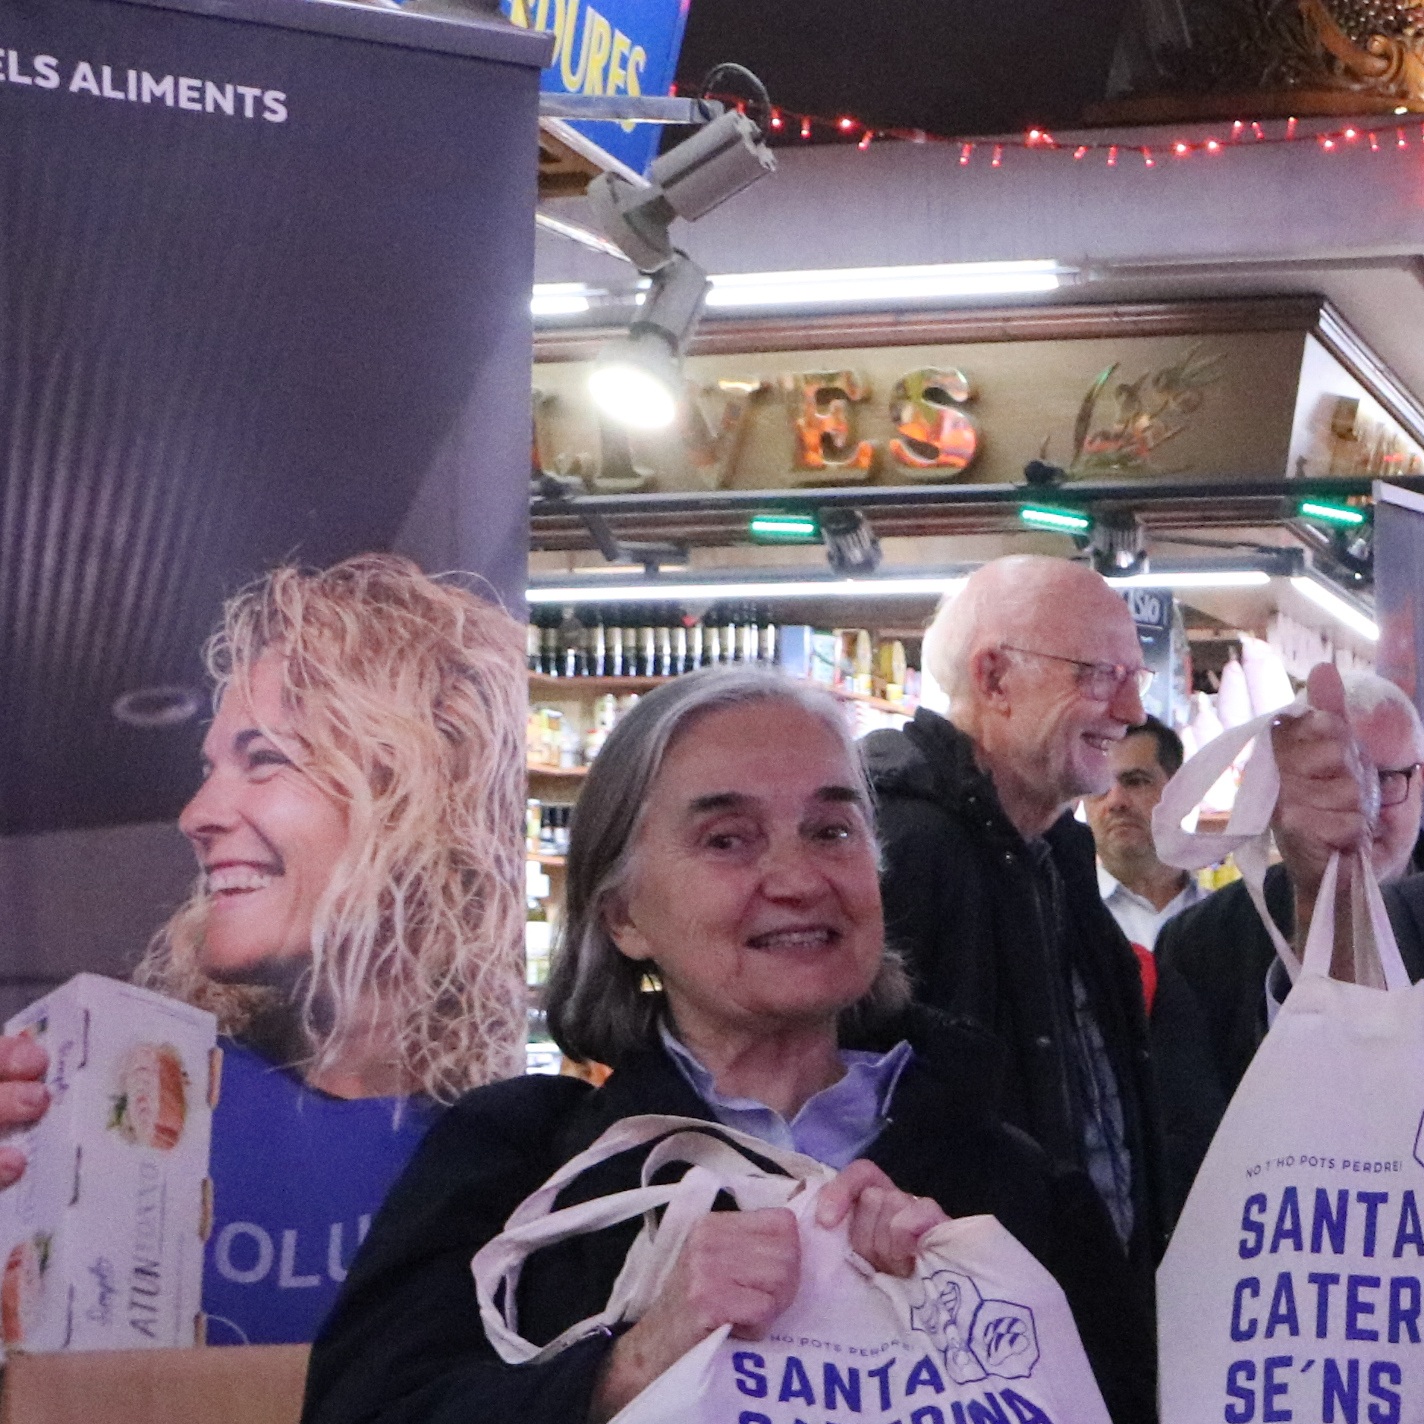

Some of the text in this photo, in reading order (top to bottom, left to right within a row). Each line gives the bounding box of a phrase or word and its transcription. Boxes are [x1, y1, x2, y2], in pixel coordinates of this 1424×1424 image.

[0, 48, 289, 124] LS ALIMENTS
[1300, 1155, 1335, 1169] POTS
[732, 1351, 945, 1413] SANTA
